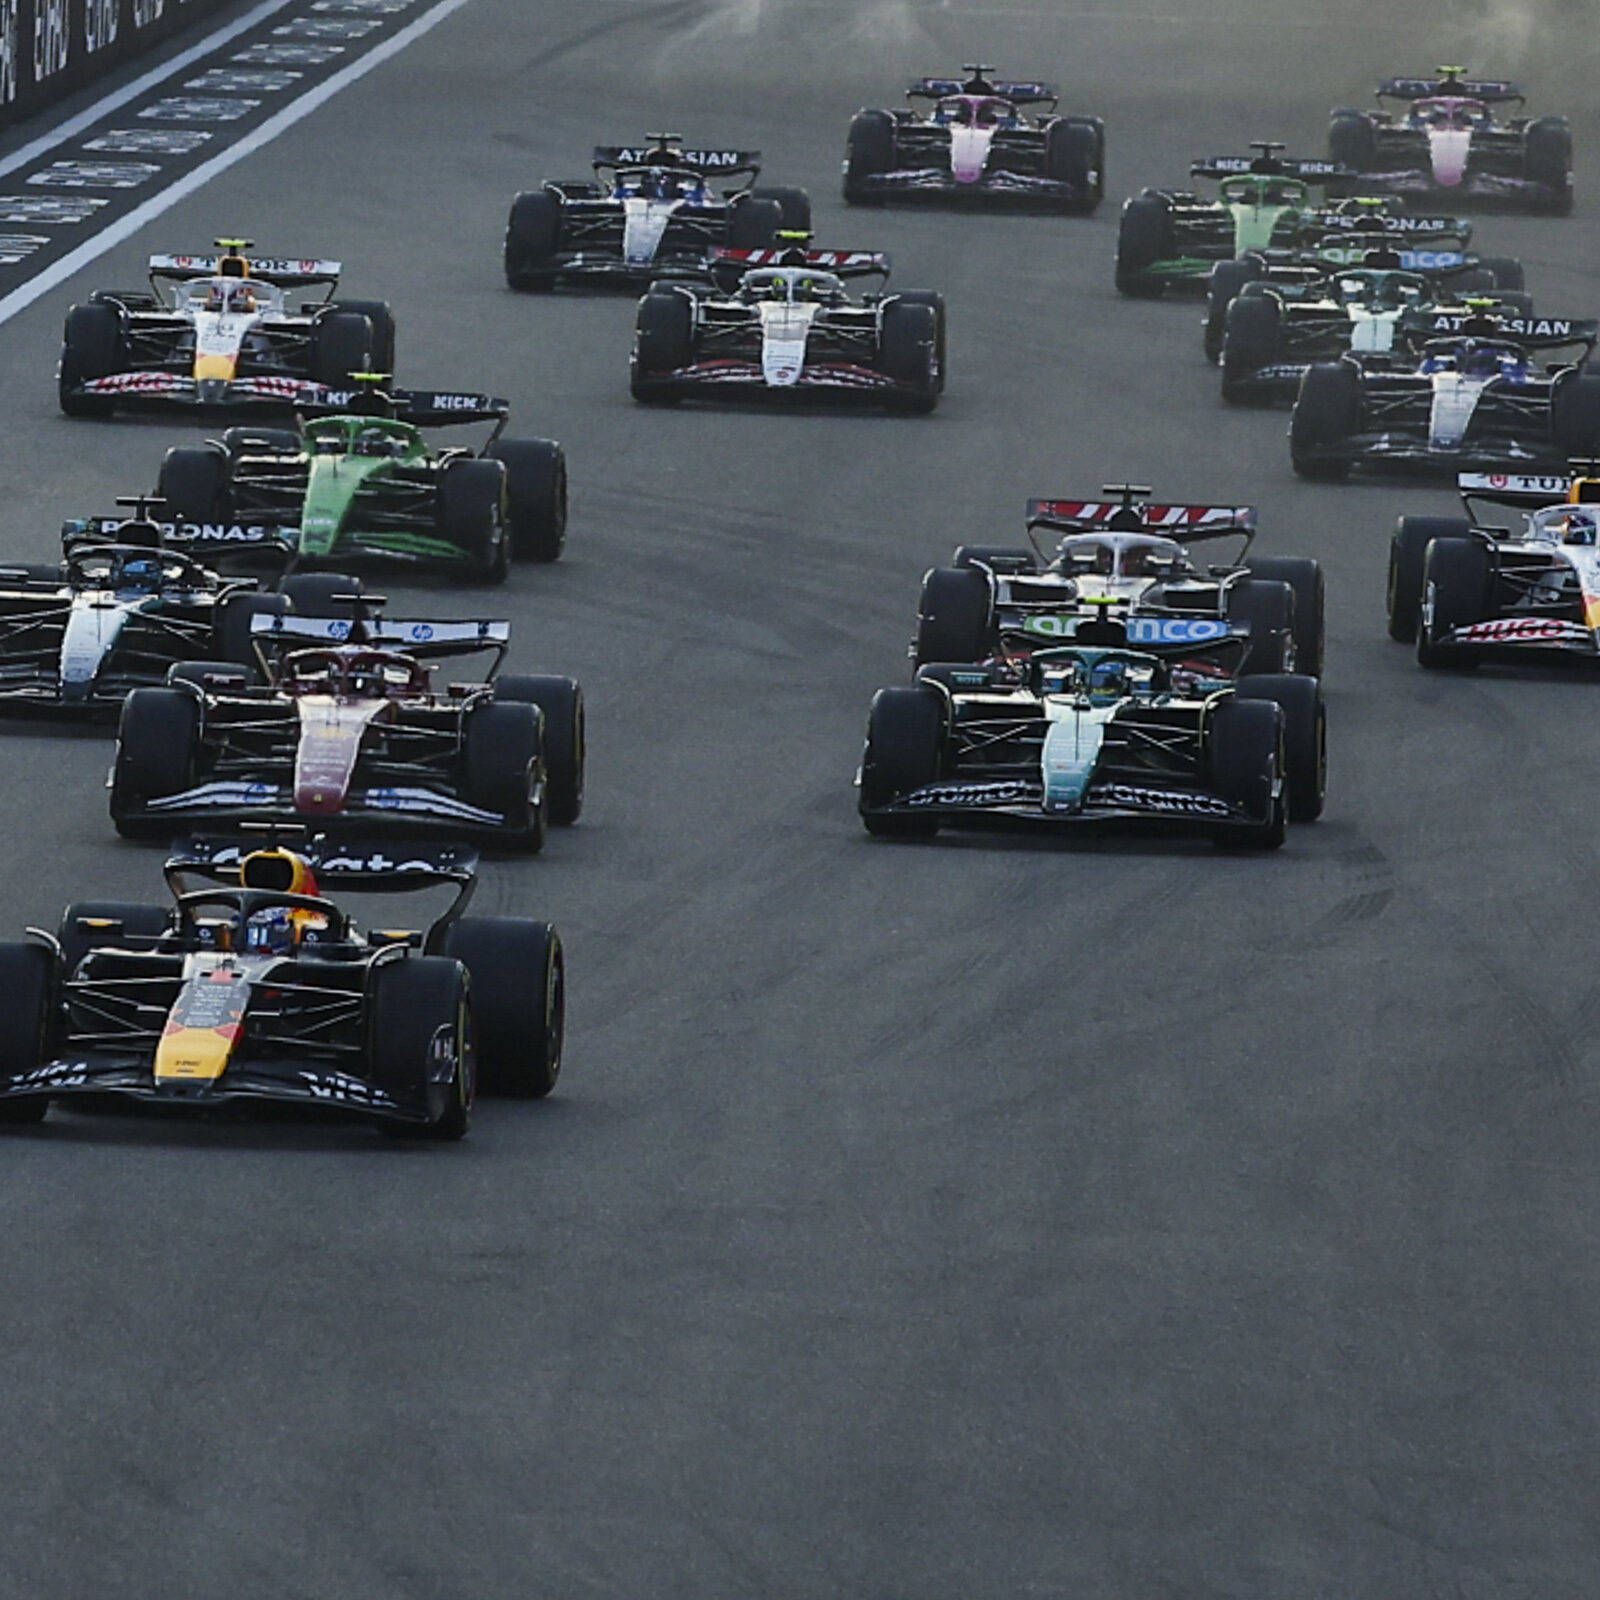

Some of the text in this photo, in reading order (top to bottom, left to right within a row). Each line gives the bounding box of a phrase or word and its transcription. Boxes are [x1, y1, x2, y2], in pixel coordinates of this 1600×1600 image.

[1325, 216, 1445, 231] PEONAS
[1434, 316, 1571, 336] ATSSIAN
[433, 396, 478, 410] KICK
[1031, 616, 1222, 641] armco
[1466, 618, 1566, 643] HUGO
